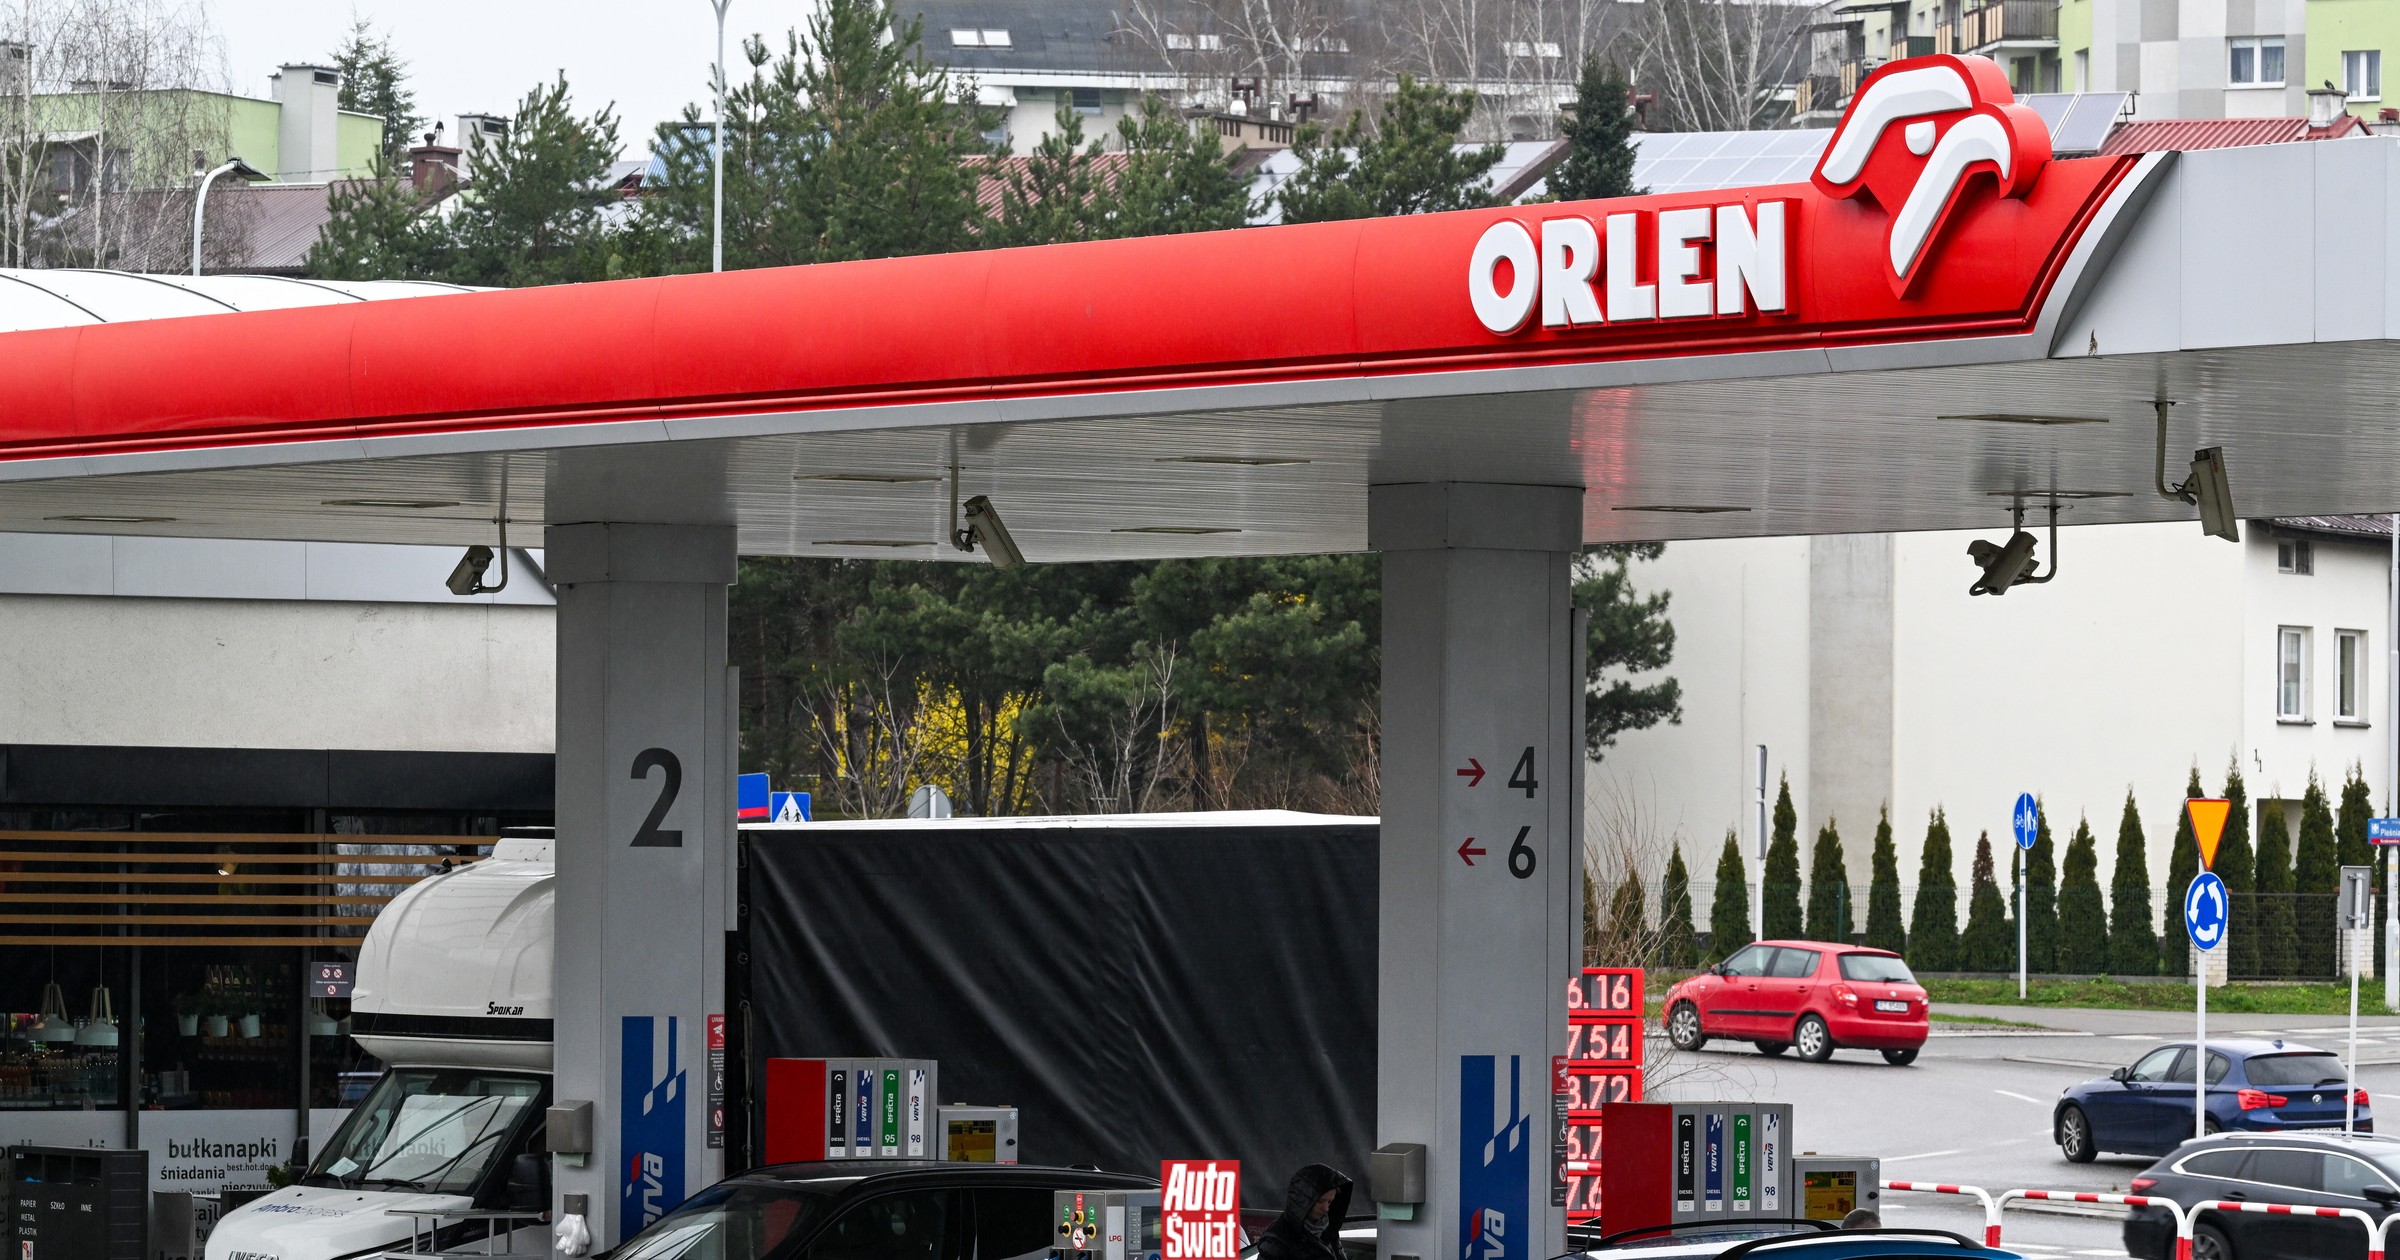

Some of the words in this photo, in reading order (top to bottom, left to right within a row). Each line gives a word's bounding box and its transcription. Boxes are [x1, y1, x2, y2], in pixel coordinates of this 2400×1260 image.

[1468, 199, 1789, 333] ORLEN
[1507, 746, 1539, 799] 4
[629, 747, 683, 848] 2
[1508, 825, 1537, 880] 6
[1568, 974, 1630, 1009] 6.16
[1568, 1024, 1629, 1060] 7.54
[884, 1134, 896, 1143] 95
[910, 1134, 921, 1143] 98
[168, 1137, 277, 1163] bułkanapki
[226, 1162, 277, 1172] best.hot.do
[160, 1165, 226, 1180] śniadania
[1736, 1186, 1748, 1197] 95
[1764, 1186, 1776, 1196] 98
[20, 1199, 37, 1208] PAPIER
[50, 1201, 66, 1210] SZKŁO
[80, 1203, 92, 1212] INNE
[20, 1213, 36, 1222] METAL
[18, 1226, 38, 1236] PLASTIK
